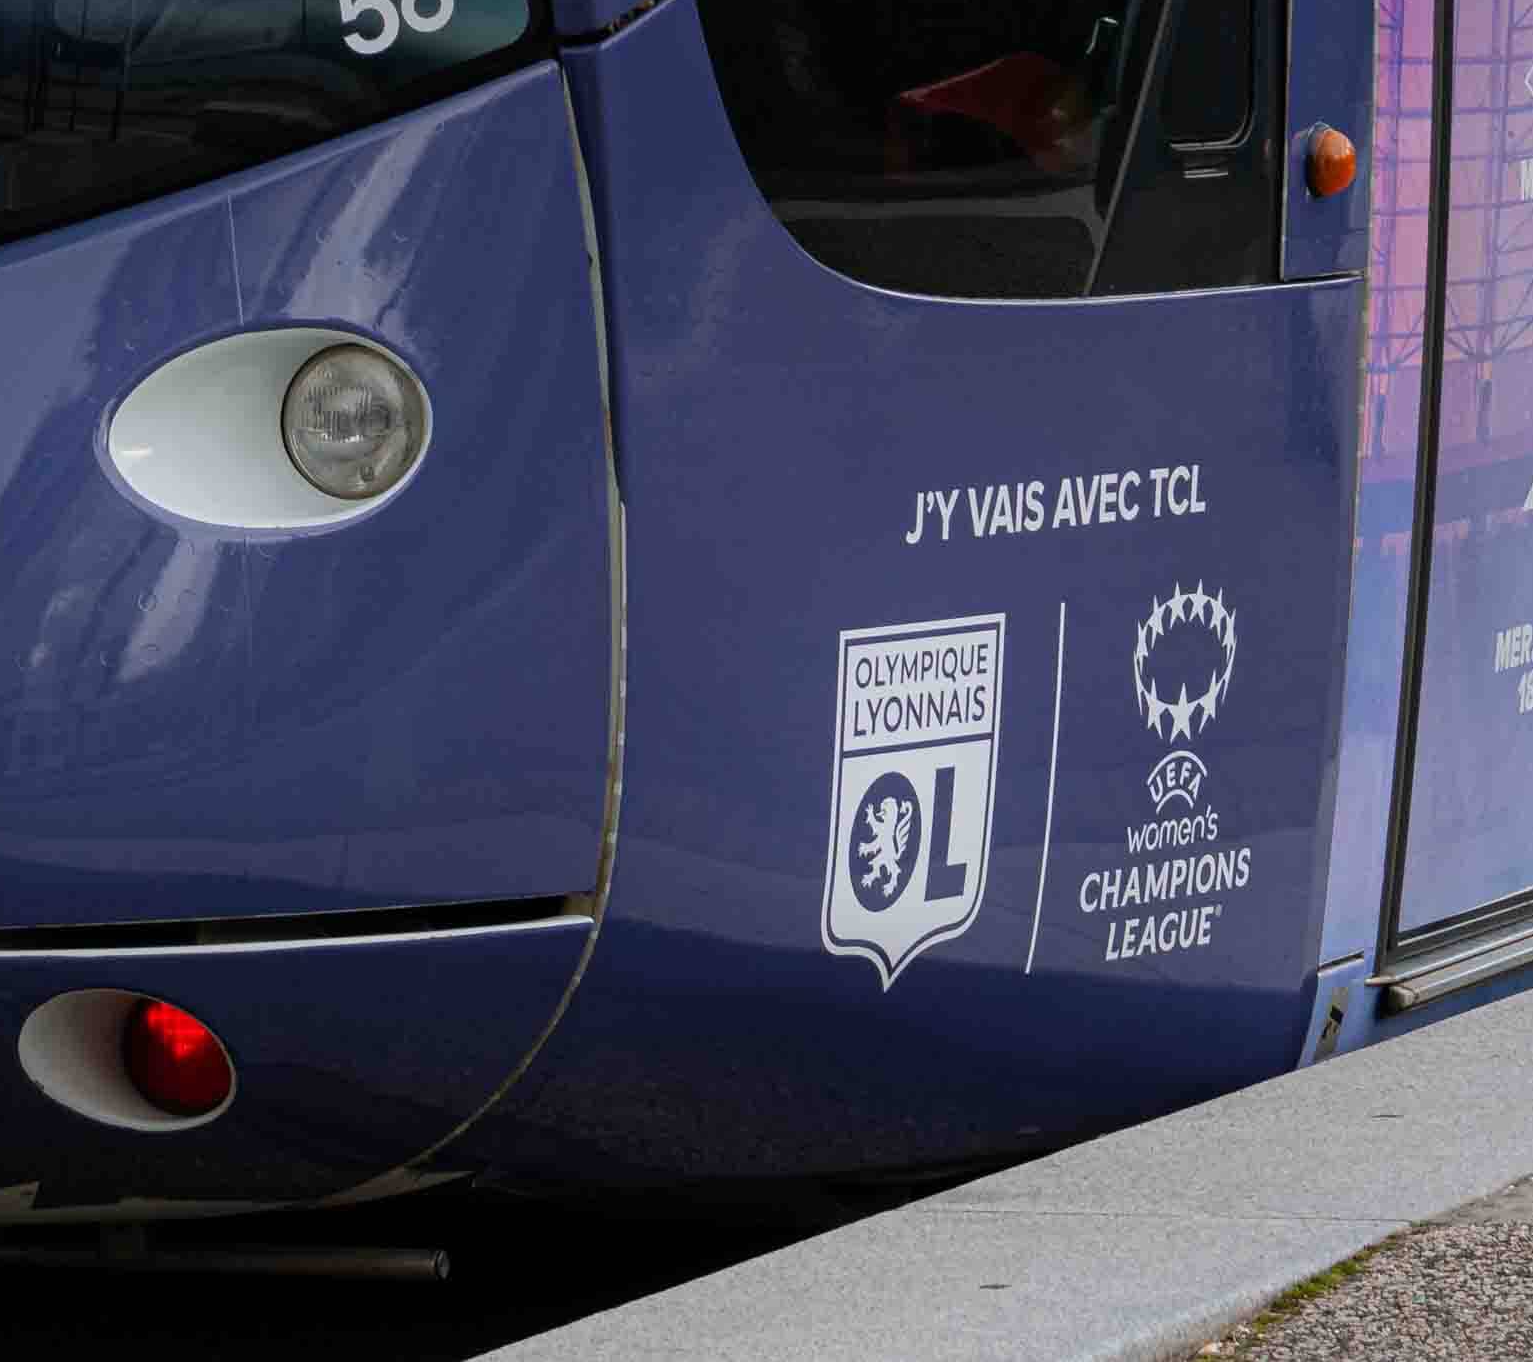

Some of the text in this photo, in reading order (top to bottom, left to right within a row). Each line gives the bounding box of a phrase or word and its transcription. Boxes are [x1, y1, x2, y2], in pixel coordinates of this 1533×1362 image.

[970, 481, 1045, 537] VAIS
[1052, 471, 1140, 527] AVEC
[1150, 464, 1206, 515] TCL
[854, 641, 989, 691] OLYMPIQUE
[853, 684, 986, 739] LYONNAIS
[1147, 758, 1202, 807] UEFA
[850, 765, 968, 913] OL
[1079, 847, 1252, 915] CHAMPIONS
[1105, 911, 1213, 961] LEAGUE
